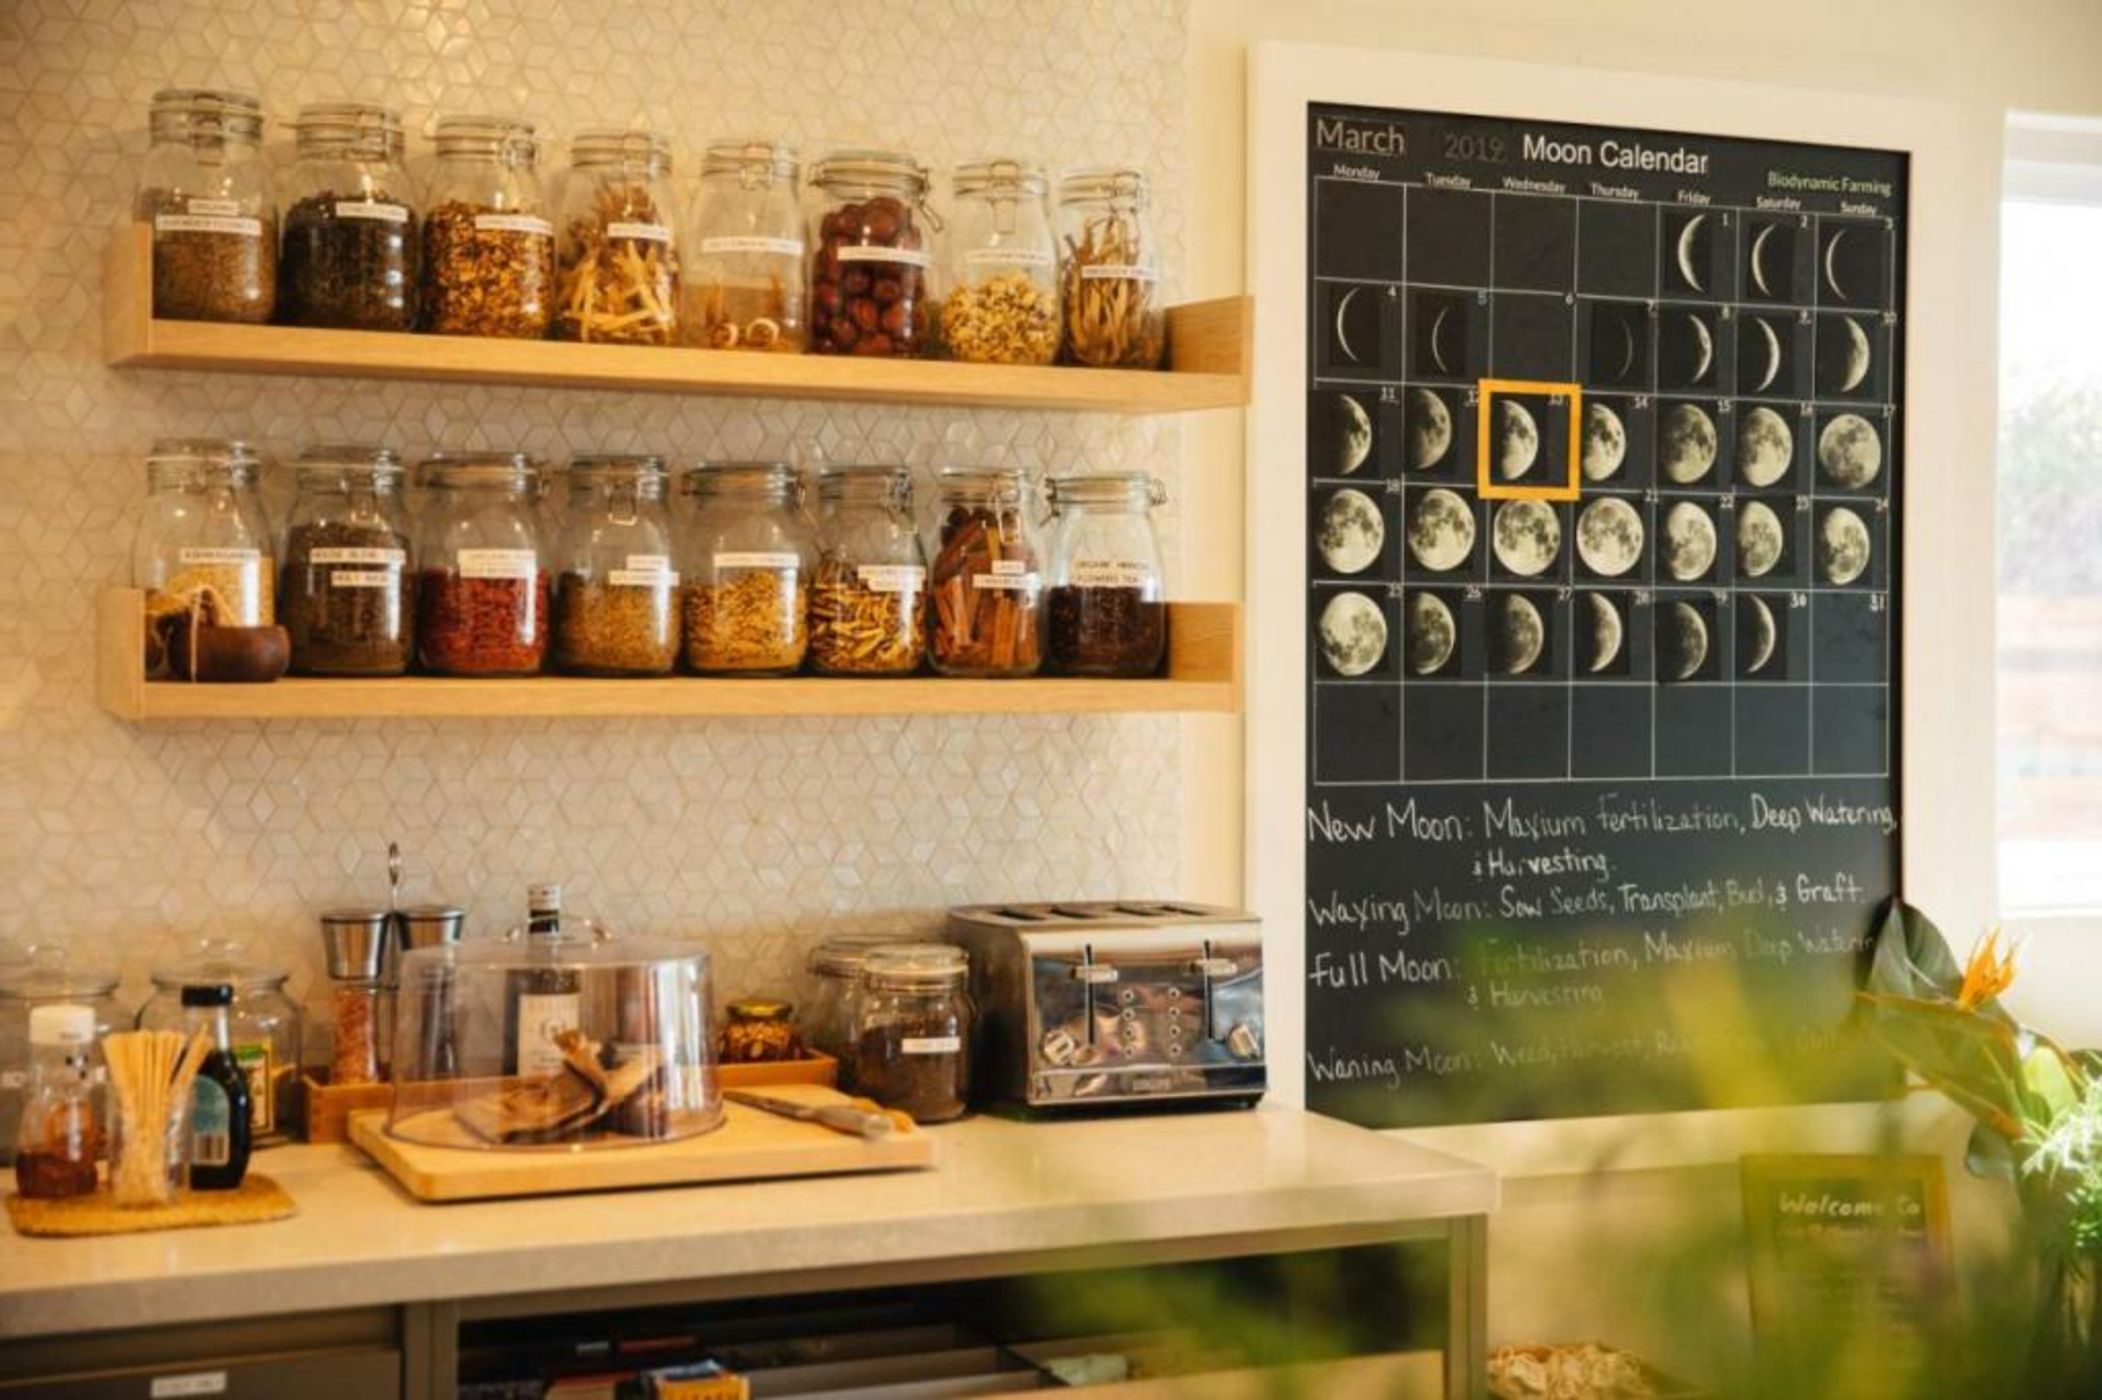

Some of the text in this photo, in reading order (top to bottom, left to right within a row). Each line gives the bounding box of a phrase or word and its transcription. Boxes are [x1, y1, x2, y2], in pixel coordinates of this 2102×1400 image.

[1316, 118, 1505, 163] March 2019
[1523, 133, 1708, 174] Moon Calendar
[1333, 164, 1877, 216] Monday Tuesday Wednesday Thursday Friday Saturday Sunday
[1767, 170, 1892, 197] Biodynamic Farming
[1387, 285, 1397, 297] 4
[1565, 292, 1574, 305] 6
[1380, 386, 1395, 401] 11
[1635, 395, 1648, 409] 14
[1718, 399, 1731, 413] 15
[1801, 401, 1813, 416] 16
[1884, 403, 1896, 417] 17
[1646, 488, 1659, 502] 21
[1720, 494, 1734, 509] 22
[1467, 583, 1481, 599] 26
[1559, 586, 1572, 600] 27
[1791, 592, 1807, 608] 30
[1870, 594, 1885, 611] 31
[1308, 799, 1376, 843] New
[1386, 797, 1474, 841] Moon:
[1482, 796, 1586, 842] Maxium
[1750, 792, 1801, 835] Deep
[1309, 889, 1410, 936] Waxing
[1499, 884, 1542, 919] Sow
[1309, 951, 1369, 988] Full
[1308, 1046, 1401, 1092] Waning
